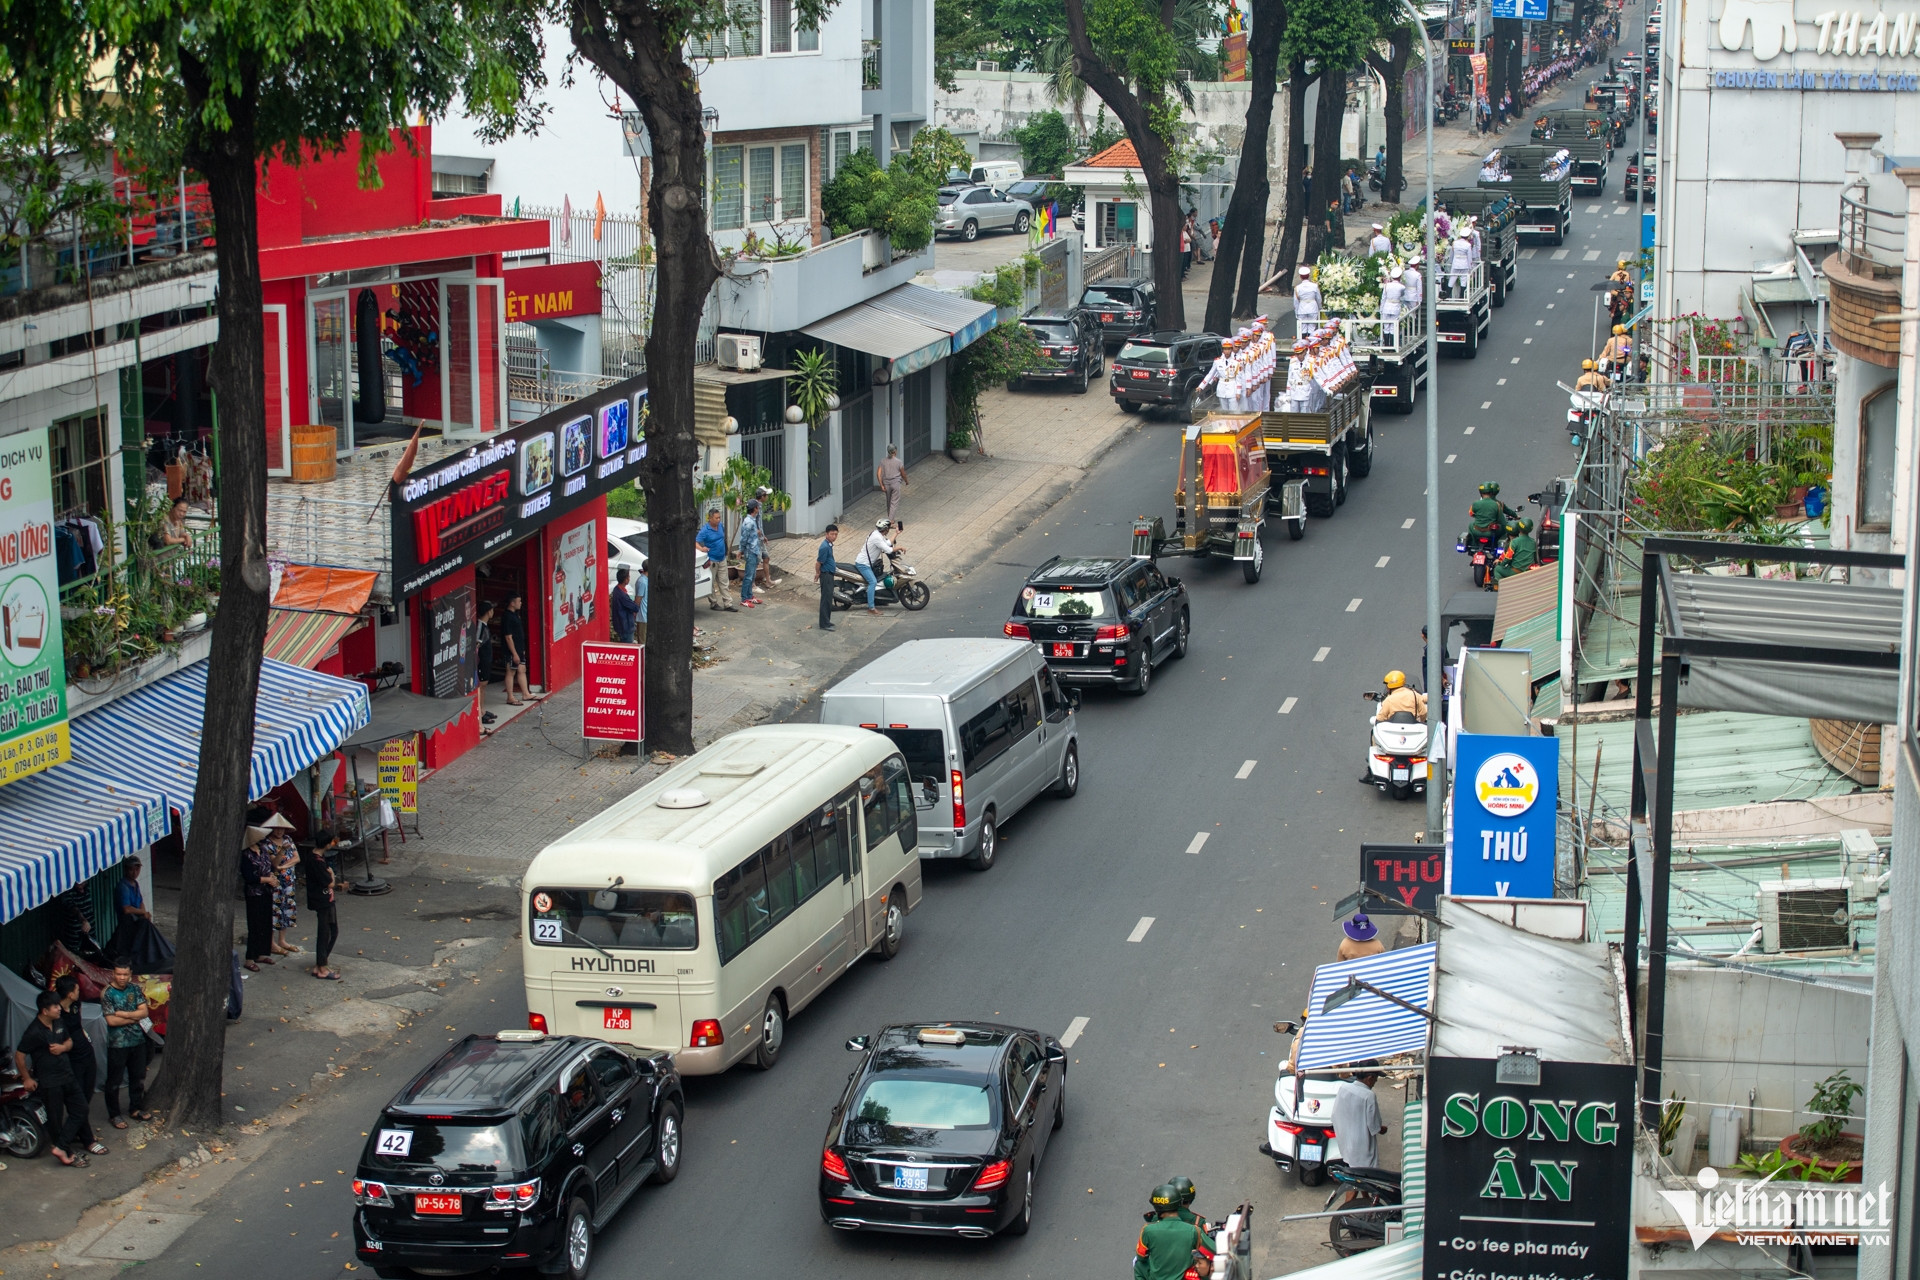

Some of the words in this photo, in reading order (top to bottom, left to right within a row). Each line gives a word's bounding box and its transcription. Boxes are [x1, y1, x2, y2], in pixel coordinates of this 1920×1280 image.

[1716, 69, 1777, 88] CHUYÊN
[1784, 69, 1816, 89] LÀM
[1822, 69, 1852, 89] TẤT
[1887, 70, 1918, 91] CÁC
[506, 290, 529, 322] ỆT
[534, 290, 573, 315] NAM
[1, 449, 26, 470] DỊCH
[28, 445, 43, 462] VỤ
[598, 455, 625, 479] BOXING
[403, 478, 428, 502] CÔNG
[428, 473, 439, 491] TY
[439, 464, 460, 487] TNHH
[564, 474, 586, 497] MMA
[522, 491, 552, 518] FITNESS
[413, 469, 511, 565] WINNER
[20, 522, 49, 560] ỨNG
[1037, 596, 1050, 606] 14
[586, 652, 635, 664] WINNER
[16, 675, 33, 696] BAO
[34, 667, 50, 690] THƯ
[596, 676, 626, 685] BOXING
[600, 687, 623, 695] MMA
[595, 697, 627, 705] FITNESS
[0, 705, 18, 733] GIẤY
[26, 701, 39, 723] TÚI
[40, 691, 58, 718] GIẤY
[587, 707, 613, 715] MUAY
[35, 736, 44, 749] Gò
[45, 730, 58, 746] Vấp
[402, 740, 415, 757] 25K
[14, 758, 31, 774] 0794
[33, 753, 45, 767] 074
[47, 747, 60, 761] 758
[380, 764, 399, 772] BÁNH
[402, 765, 415, 782] 20K
[382, 775, 396, 783] ƯỚT
[402, 792, 415, 807] 30K
[1480, 826, 1528, 862] THÚ
[1374, 854, 1442, 882] THÚ
[1397, 886, 1420, 907] Y
[538, 924, 556, 938] 22
[572, 957, 655, 973] HYUNDAI
[612, 1009, 623, 1019] KP
[606, 1019, 630, 1029] 47-08
[1442, 1092, 1620, 1146] SONG
[383, 1134, 405, 1151] 42
[895, 1177, 926, 1190] 039.95
[1480, 1147, 1578, 1201] ÂN
[416, 1196, 461, 1210] KP-56-78
[366, 1240, 383, 1250] 02-01
[1514, 1240, 1548, 1256] pha
[1551, 1240, 1589, 1259] máy
